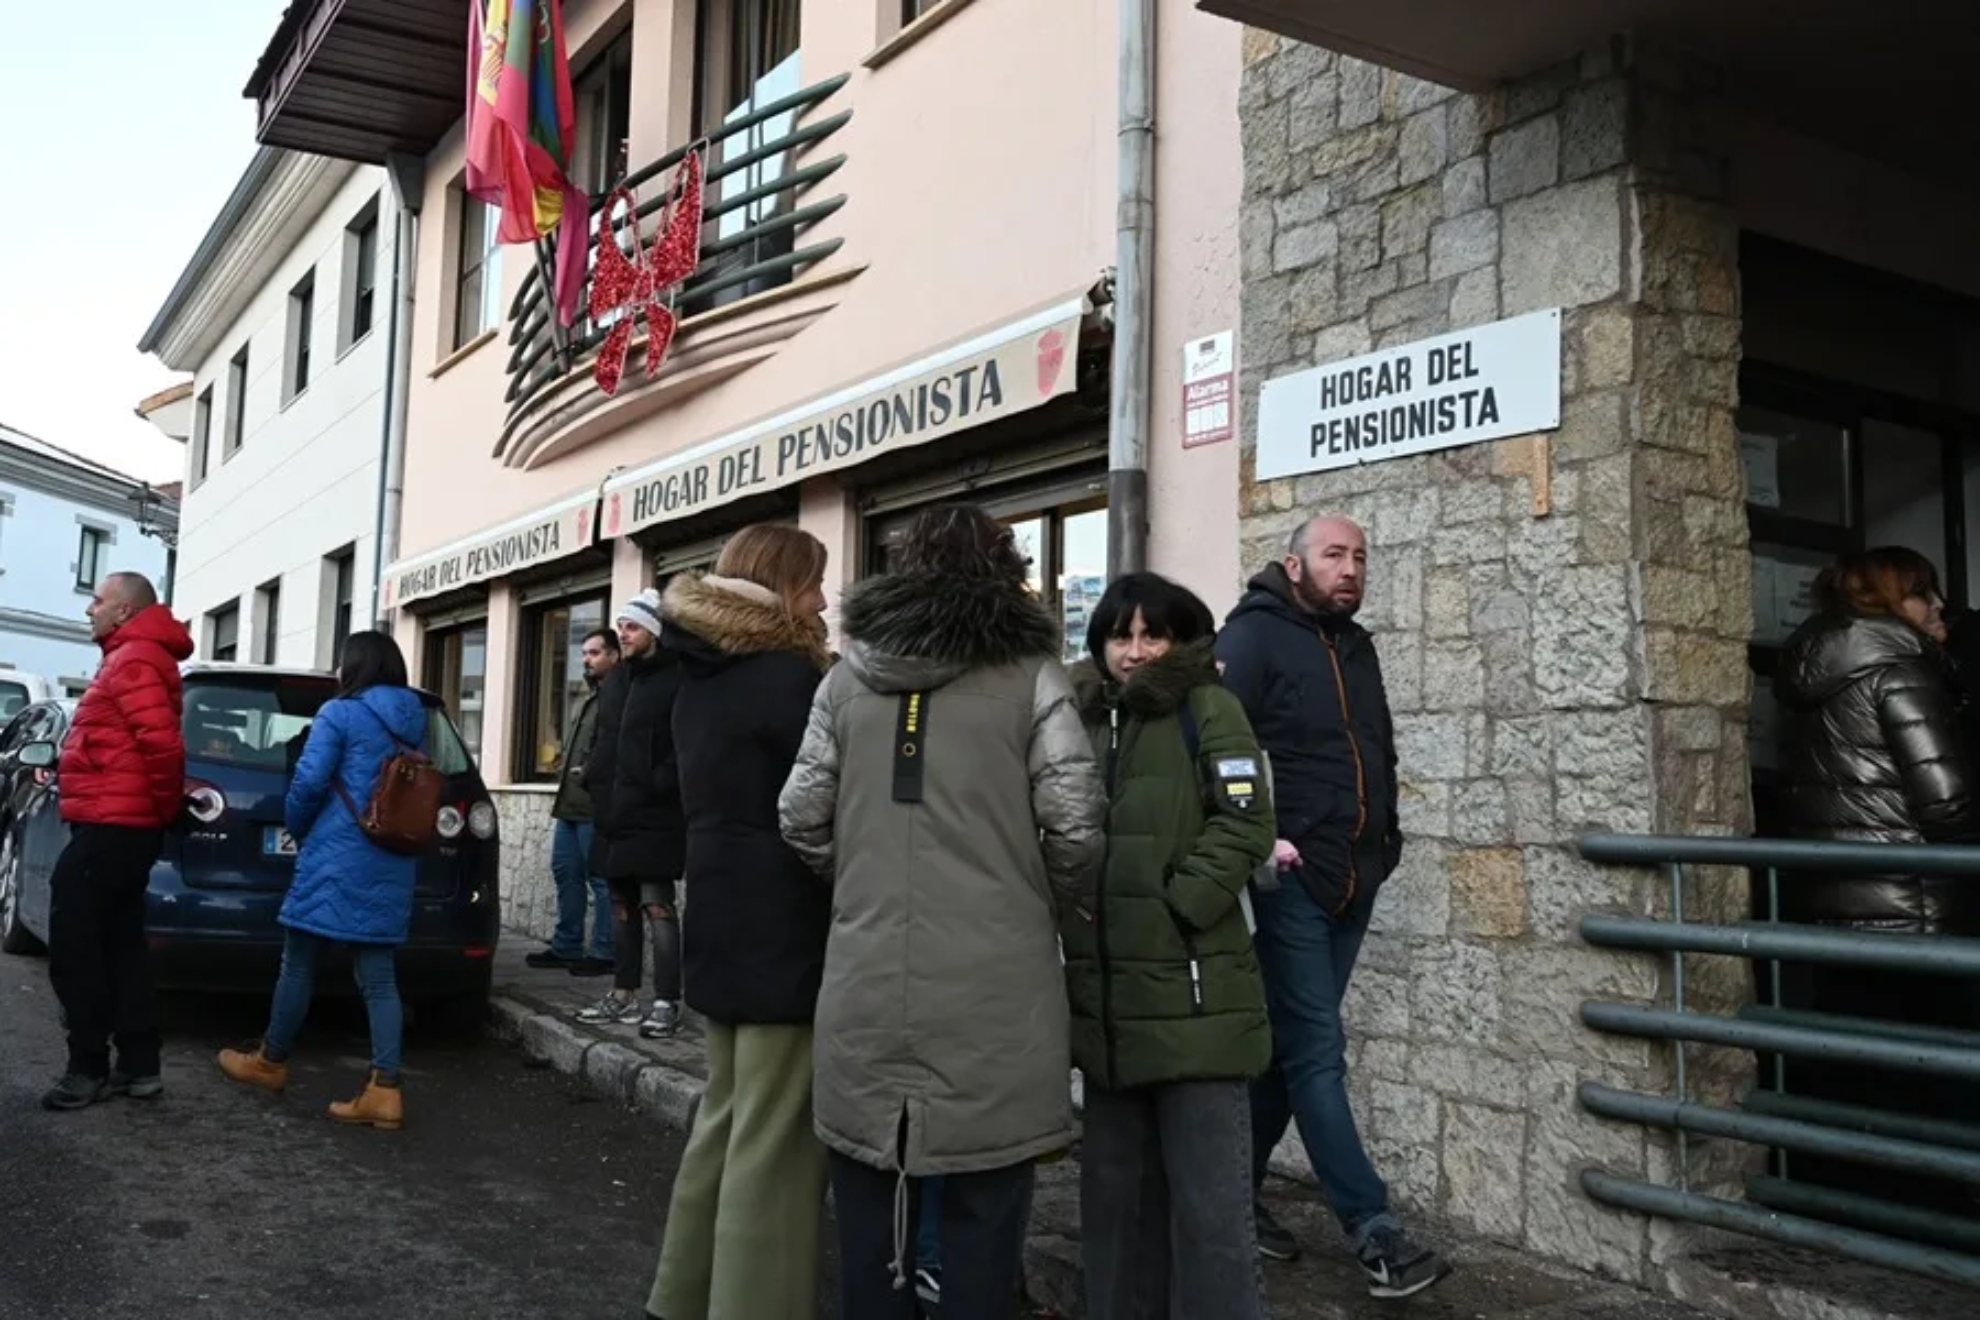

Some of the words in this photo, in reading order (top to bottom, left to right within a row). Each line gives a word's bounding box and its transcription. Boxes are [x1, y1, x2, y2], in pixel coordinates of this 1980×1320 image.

[1321, 356, 1412, 410] HOGAR
[1428, 341, 1479, 386] DEL
[633, 465, 709, 522] HOGAR
[718, 447, 766, 495] DEL
[777, 358, 1003, 477] PENSIONISTA
[1310, 387, 1500, 458] PENSIONISTA
[398, 564, 436, 599] HOGAR
[439, 555, 462, 585] DEL
[466, 520, 560, 577] PENSIONISTA
